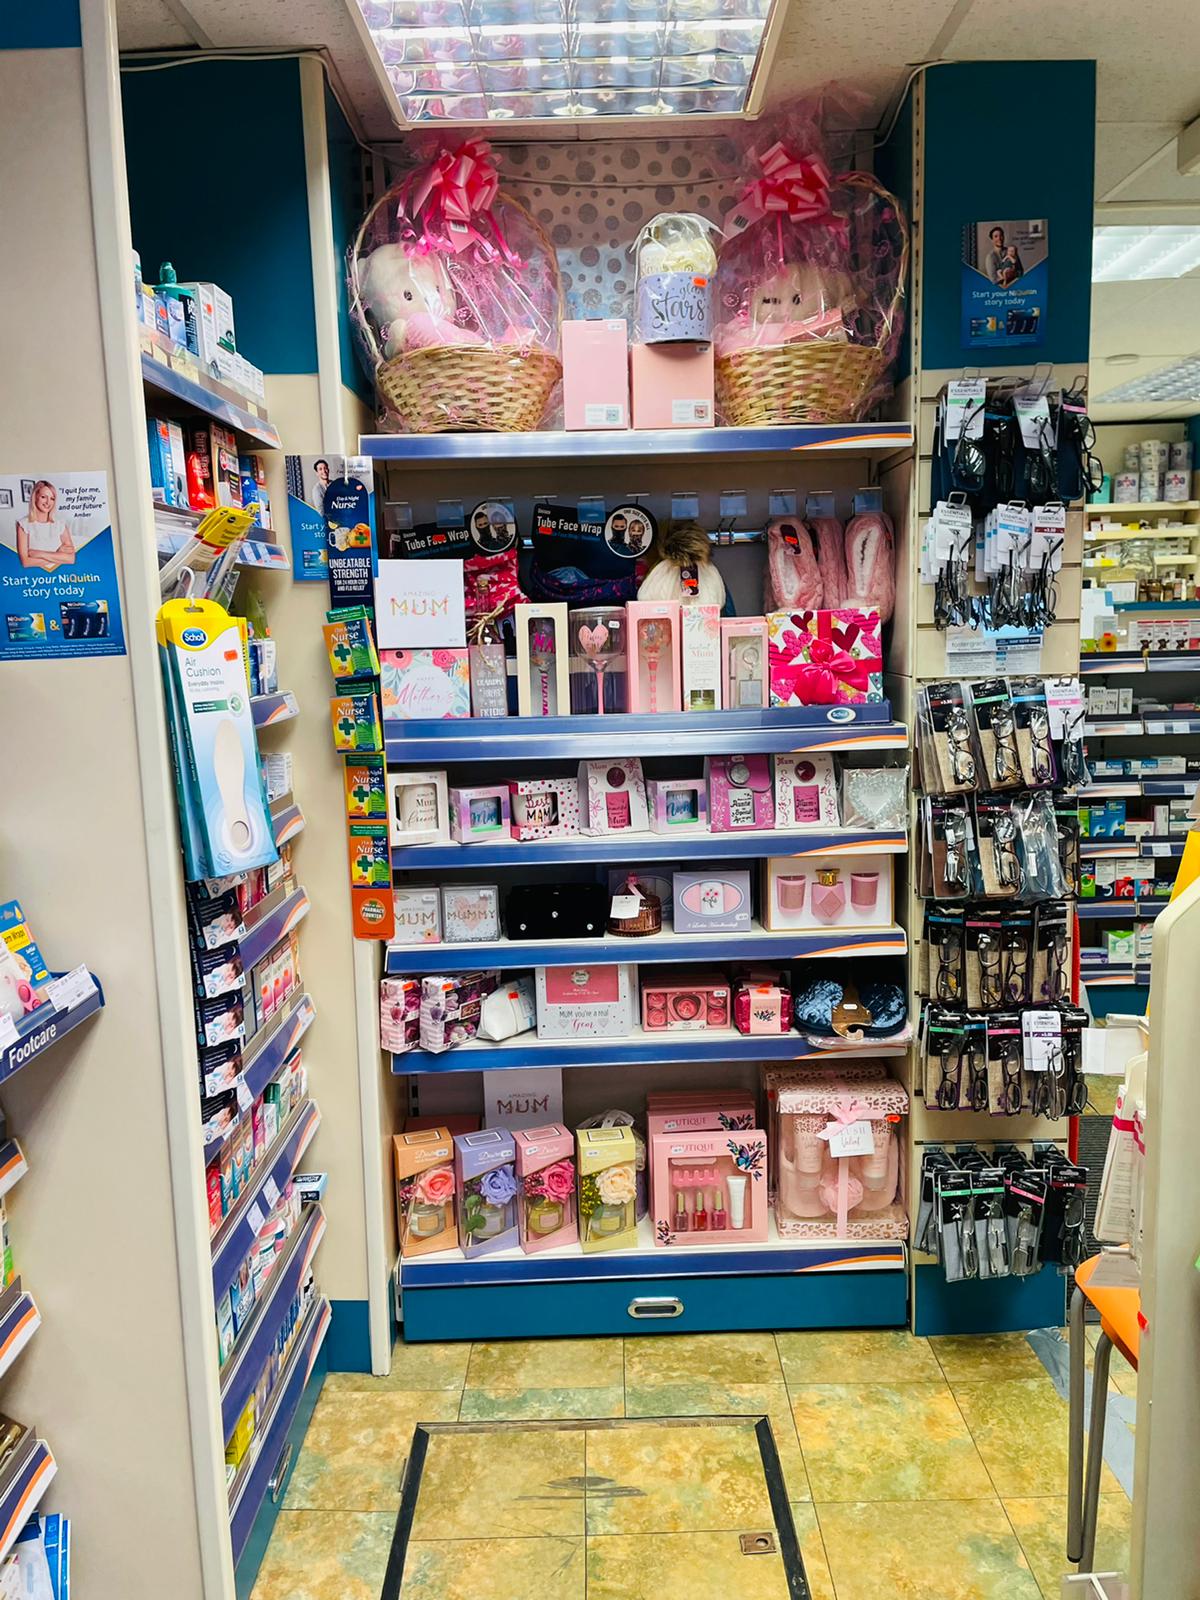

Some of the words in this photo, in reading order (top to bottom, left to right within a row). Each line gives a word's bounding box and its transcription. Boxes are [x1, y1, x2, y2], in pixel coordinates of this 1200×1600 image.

[972, 291, 990, 299] Start
[991, 290, 1008, 300] your
[984, 298, 1003, 307] story
[1004, 297, 1026, 306] today
[651, 291, 706, 329] stars
[65, 487, 78, 496] quit
[78, 486, 88, 496] for
[76, 494, 97, 502] family
[331, 501, 357, 509] Nurse
[941, 509, 969, 517] ESSENTIALS
[1000, 512, 1028, 522] ESSENTIALS
[301, 523, 320, 531] Start
[537, 516, 557, 528] Tube
[558, 519, 579, 531] Face
[580, 523, 602, 536] Wrap
[405, 538, 426, 551] Tube
[447, 530, 470, 542] Wrap
[329, 558, 371, 569] UNBEATABLE
[333, 568, 368, 579] STRENGTH
[3, 575, 29, 586] Start
[31, 575, 57, 587] your
[58, 573, 101, 584] NiQuitin
[23, 588, 51, 599] story
[53, 585, 85, 598] today
[390, 596, 449, 616] MUM
[184, 632, 205, 642] Scholl
[331, 631, 359, 642] Nurse
[185, 657, 197, 667] Air
[186, 667, 221, 678] Cushion
[337, 705, 365, 716] Nurse
[352, 775, 380, 784] Nurse
[525, 791, 551, 808] Best
[356, 845, 384, 854] Nurse
[447, 909, 496, 921] MUMMY
[8, 1023, 57, 1069] Footcare
[497, 1094, 550, 1115] MUM
[671, 1143, 714, 1152] UTIQUE
